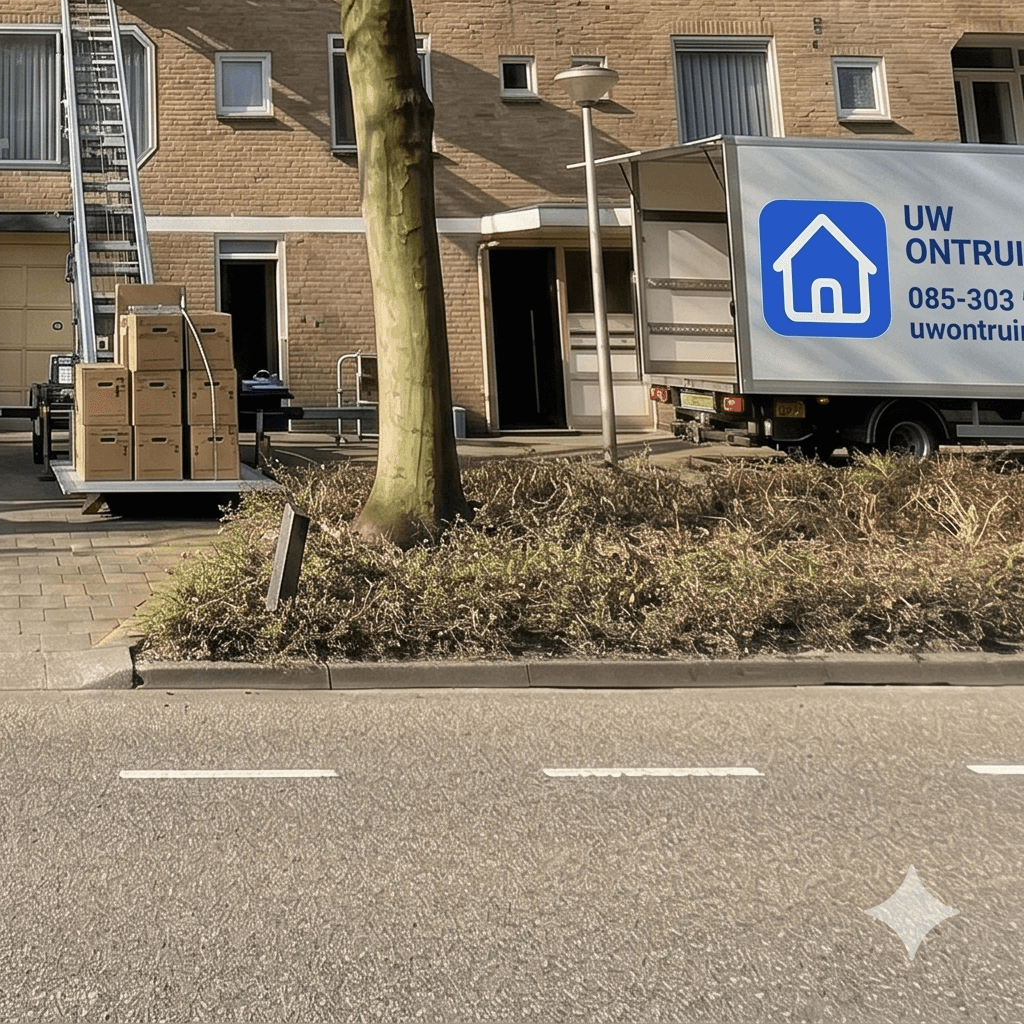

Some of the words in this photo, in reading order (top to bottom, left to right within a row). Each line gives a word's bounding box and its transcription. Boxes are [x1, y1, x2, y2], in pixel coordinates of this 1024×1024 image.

[903, 204, 954, 232] UW
[905, 237, 1024, 267] ONTRUI
[908, 286, 1015, 312] 085-303
[909, 318, 1024, 342] uwontrui
